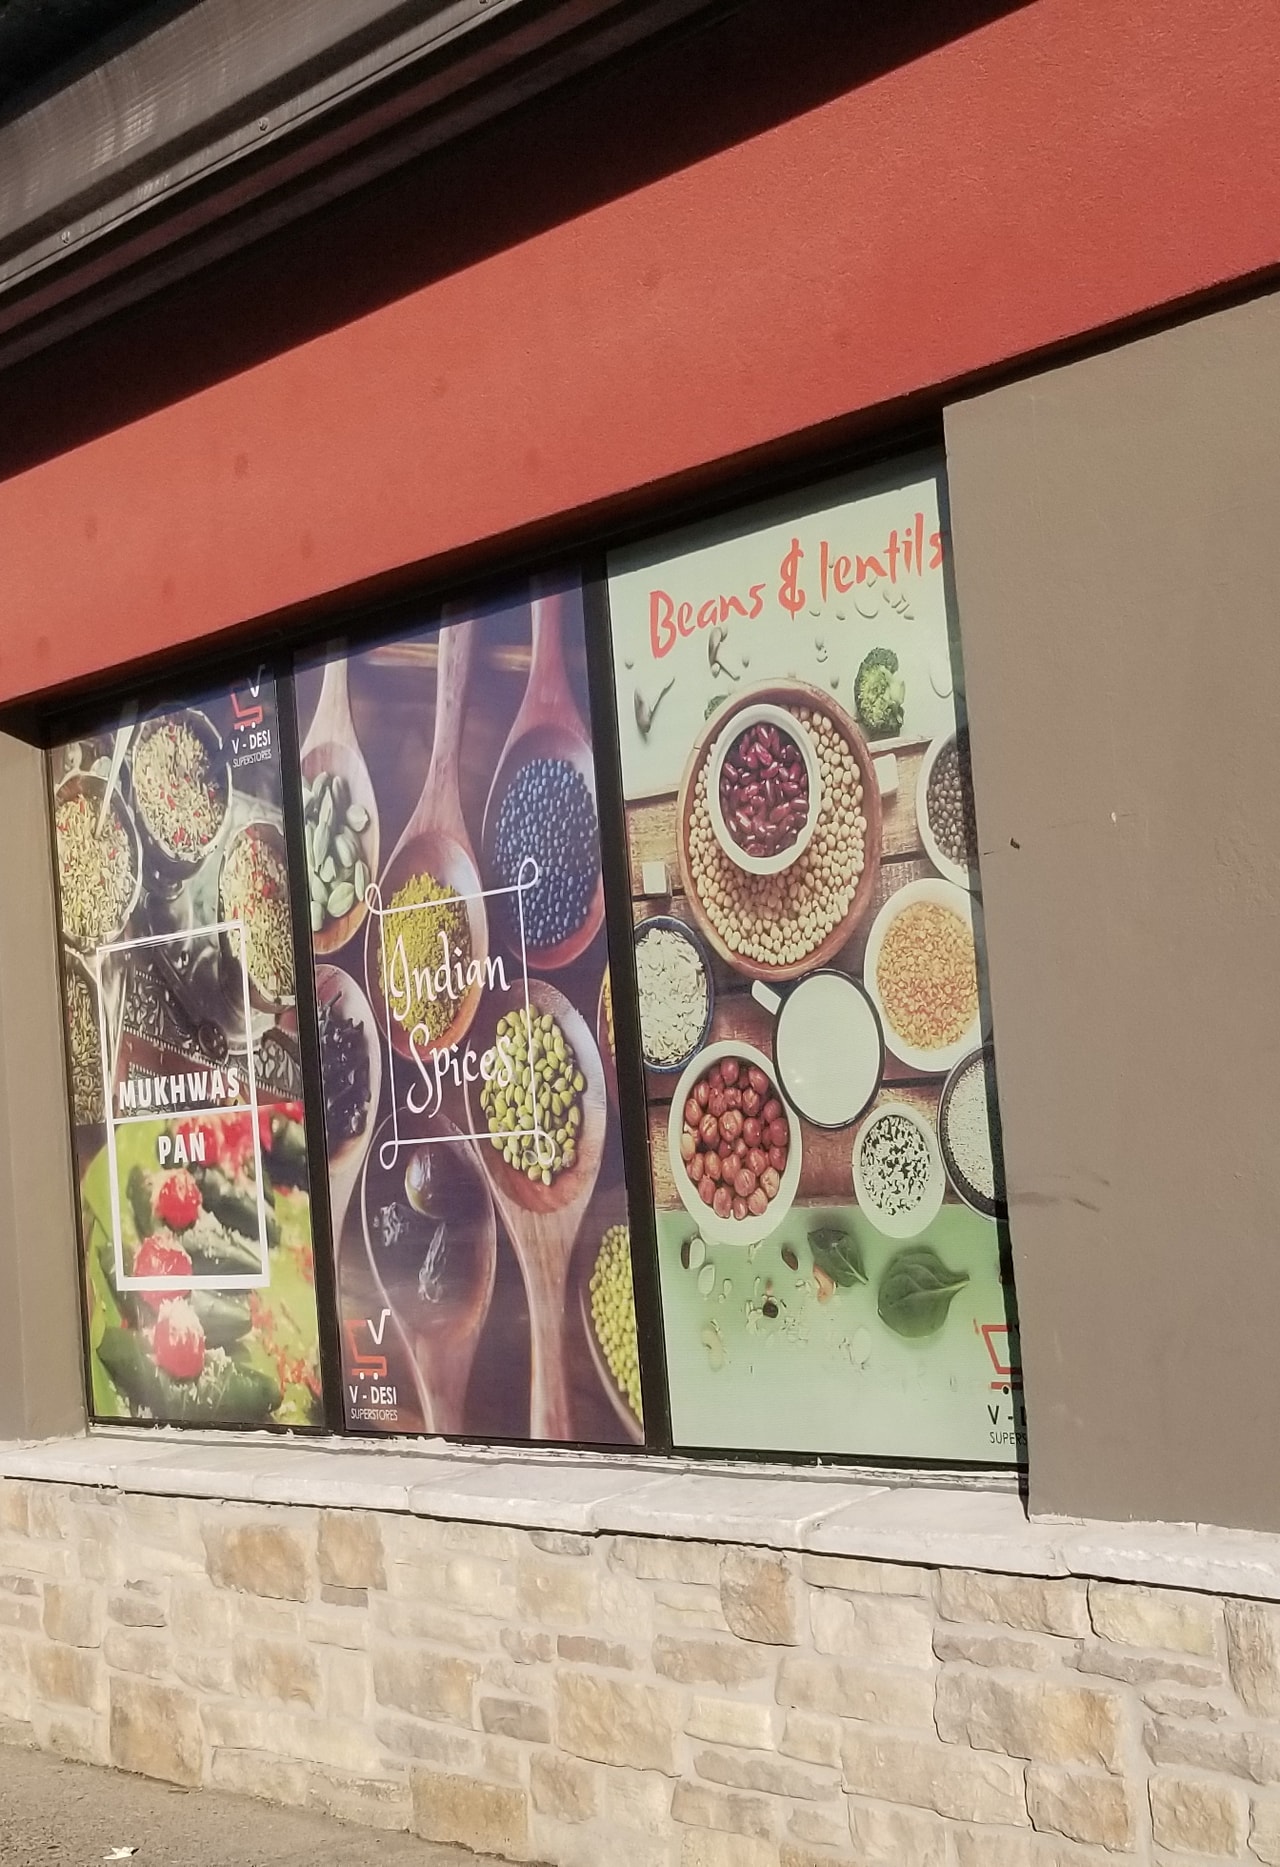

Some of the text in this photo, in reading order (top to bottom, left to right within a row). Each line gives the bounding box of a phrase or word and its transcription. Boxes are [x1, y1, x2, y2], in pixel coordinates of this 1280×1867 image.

[648, 583, 767, 659] Beans
[778, 537, 807, 621] &
[231, 737, 240, 755] V
[249, 730, 272, 750] DESI
[389, 930, 512, 1022] Indian
[406, 1022, 513, 1119] Spices
[120, 1067, 240, 1110] MUKHWAS
[158, 1132, 206, 1165] PAN
[349, 1385, 359, 1404] V
[370, 1385, 398, 1405] DESI
[350, 1407, 398, 1421] SUPERSTORES
[987, 1404, 1000, 1425] V
